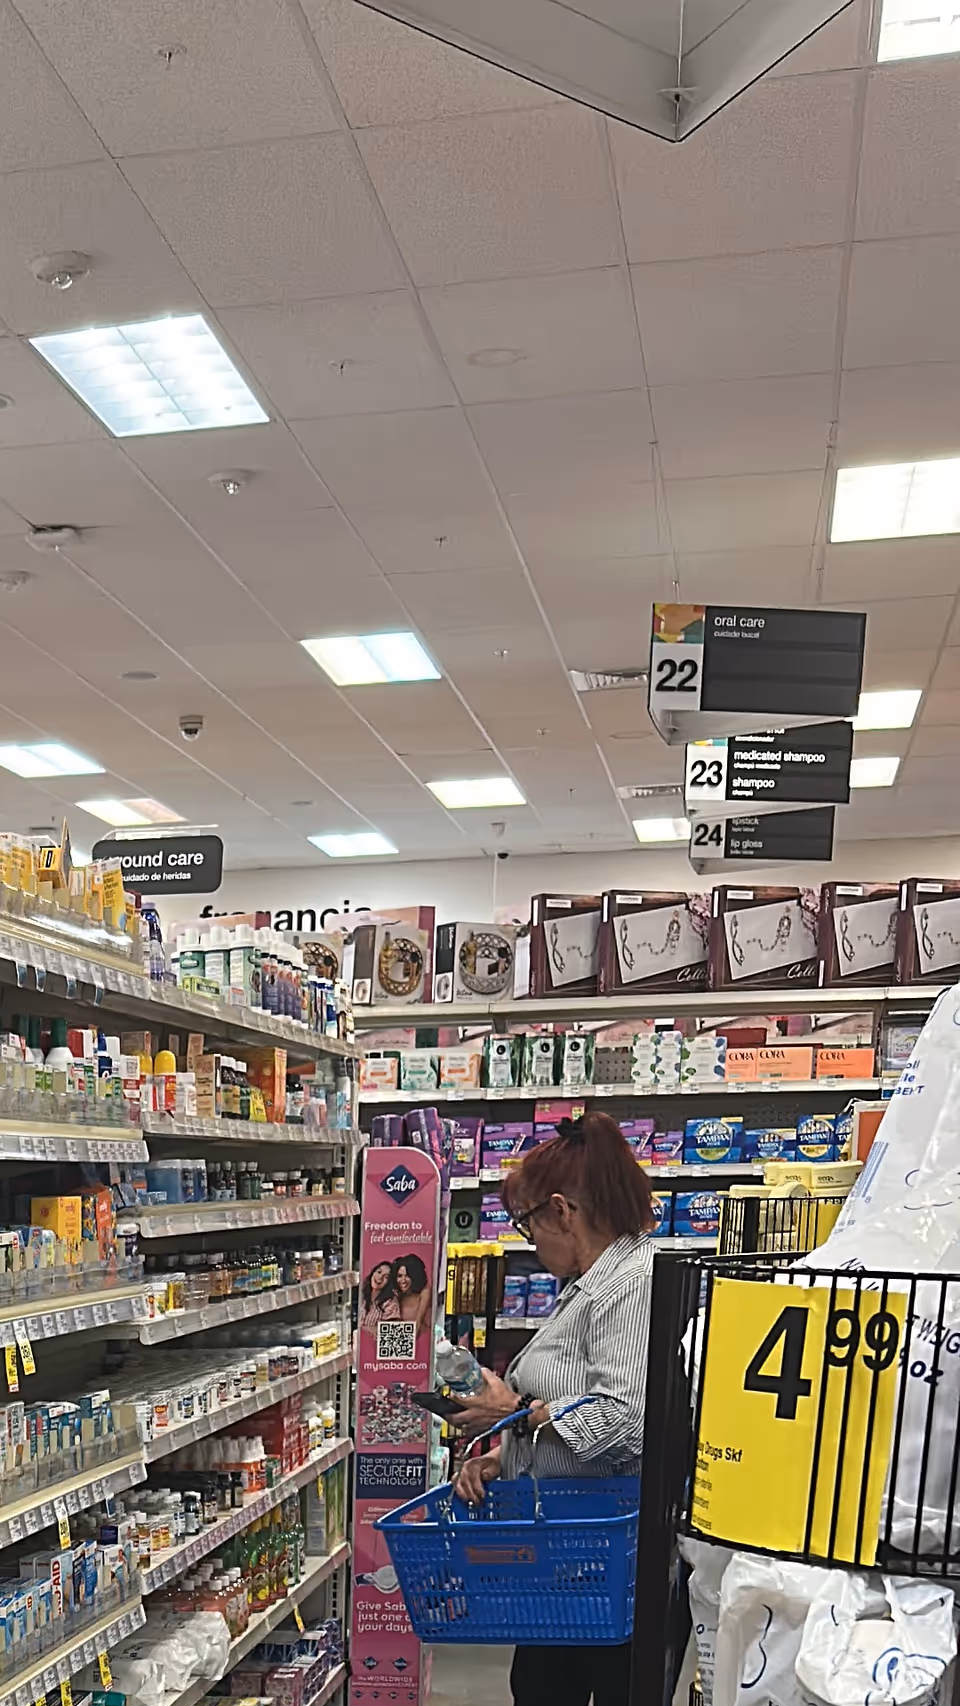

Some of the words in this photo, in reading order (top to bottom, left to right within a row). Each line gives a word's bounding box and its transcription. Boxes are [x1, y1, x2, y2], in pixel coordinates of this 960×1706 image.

[714, 615, 736, 628] oral
[740, 617, 765, 629] care
[655, 658, 698, 692] 22
[734, 750, 782, 762] medicated
[783, 752, 826, 765] shampoo
[690, 760, 723, 787] 23
[732, 777, 775, 790] shampoo
[694, 823, 723, 846] 24
[730, 839, 740, 849] lip
[742, 840, 763, 851] gloss
[167, 851, 204, 866] care
[150, 872, 161, 881] de
[163, 871, 191, 881] heridas
[759, 1049, 786, 1060] CORA
[820, 1050, 846, 1061] CORA
[696, 1133, 730, 1145] TAMPAX
[800, 1132, 828, 1142] TAMPAX
[385, 1174, 416, 1192] Saba
[364, 1221, 409, 1231] Freedom
[411, 1221, 423, 1230] to
[370, 1232, 385, 1244] feel
[385, 1230, 433, 1243] comfortable
[363, 1361, 428, 1372] mysaba.com
[360, 1456, 374, 1464] The
[374, 1457, 391, 1466] only
[408, 1456, 423, 1464] with
[360, 1465, 423, 1478] SECUREFIT
[360, 1477, 423, 1486] TECHNOLOGY
[356, 1601, 382, 1611] Give
[384, 1601, 406, 1611] Sab
[358, 1611, 378, 1622] just
[381, 1613, 402, 1621] one
[358, 1623, 384, 1633] your
[385, 1622, 413, 1634] days
